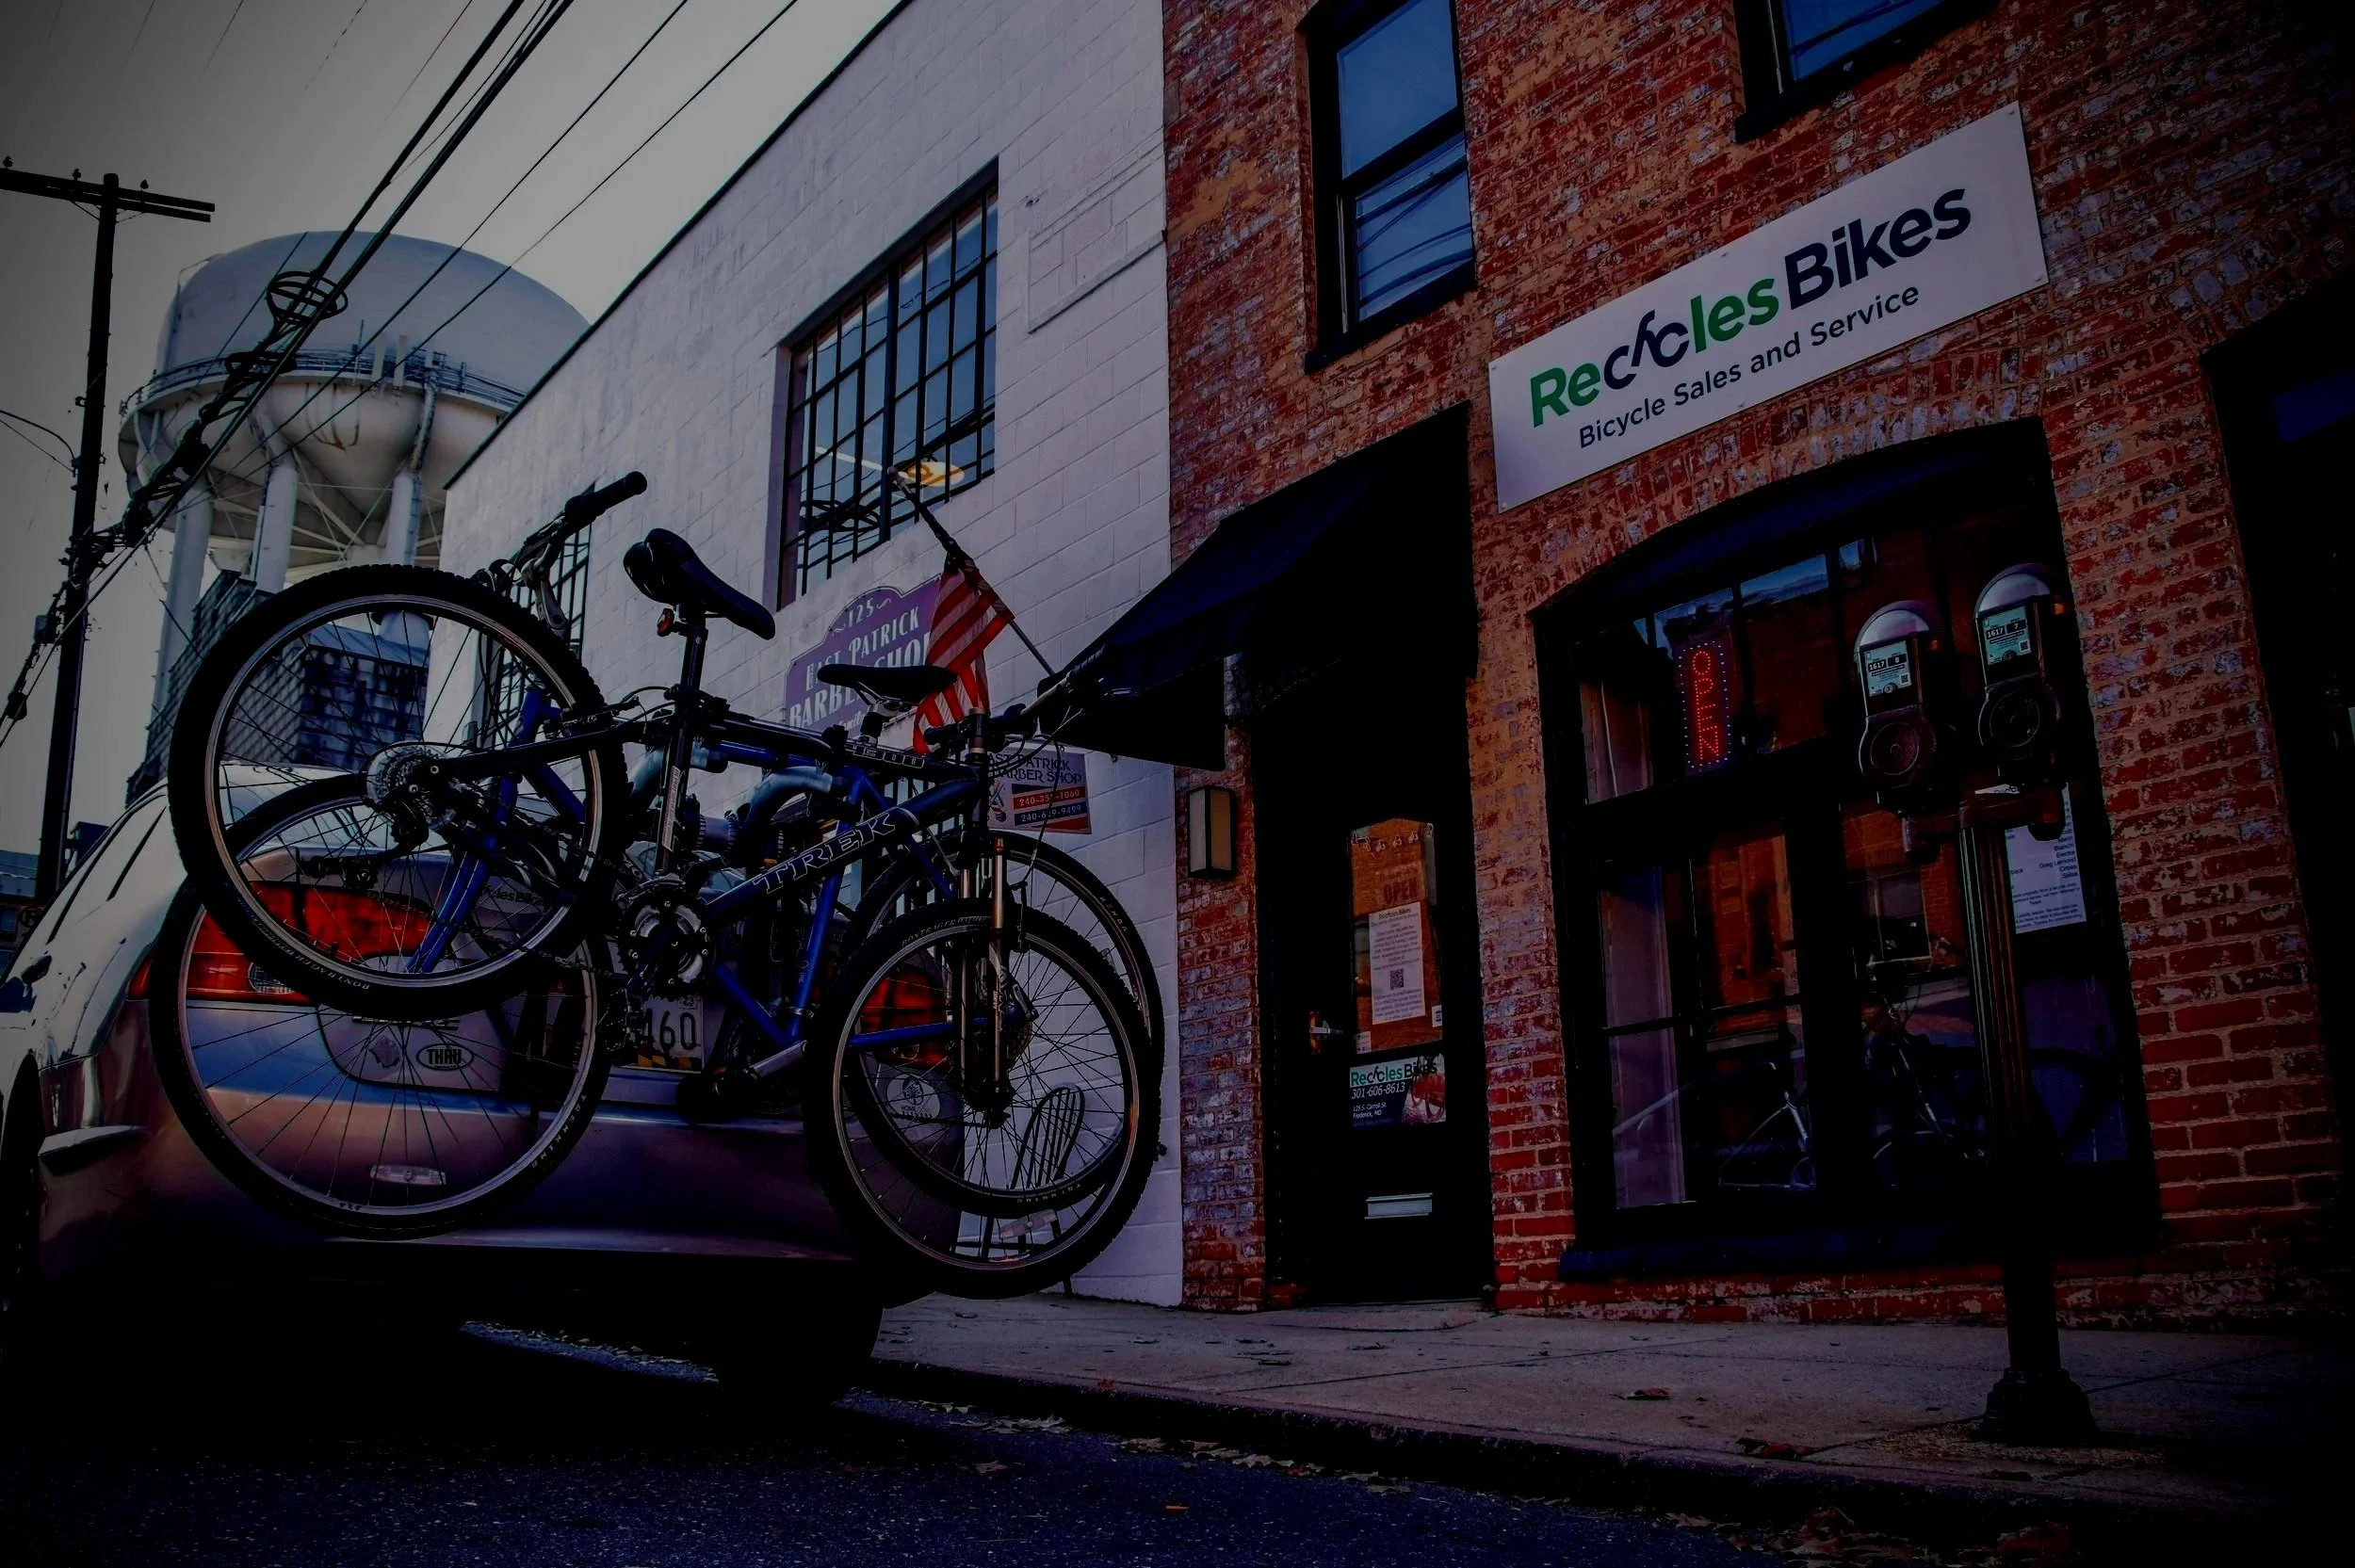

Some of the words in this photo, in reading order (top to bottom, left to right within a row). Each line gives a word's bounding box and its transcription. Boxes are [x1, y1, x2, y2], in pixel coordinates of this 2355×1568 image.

[1579, 398, 1665, 449] Bicycle
[1673, 364, 1742, 407] Sales
[1750, 332, 1803, 374] and
[1811, 285, 1920, 347] Service
[848, 598, 874, 628] 125
[849, 606, 920, 666] PATRICK
[1987, 627, 2004, 639] 1617
[789, 685, 861, 729] BARBE
[873, 631, 932, 669] HO
[1869, 661, 1885, 671] 1617
[1693, 650, 1720, 761] OPEN
[997, 768, 1044, 783] ARBER
[1048, 771, 1082, 784] SHOP
[1019, 789, 1080, 807] 240-35-1060
[753, 813, 896, 894] TREK
[1351, 1081, 1406, 1100] 301-606-8613
